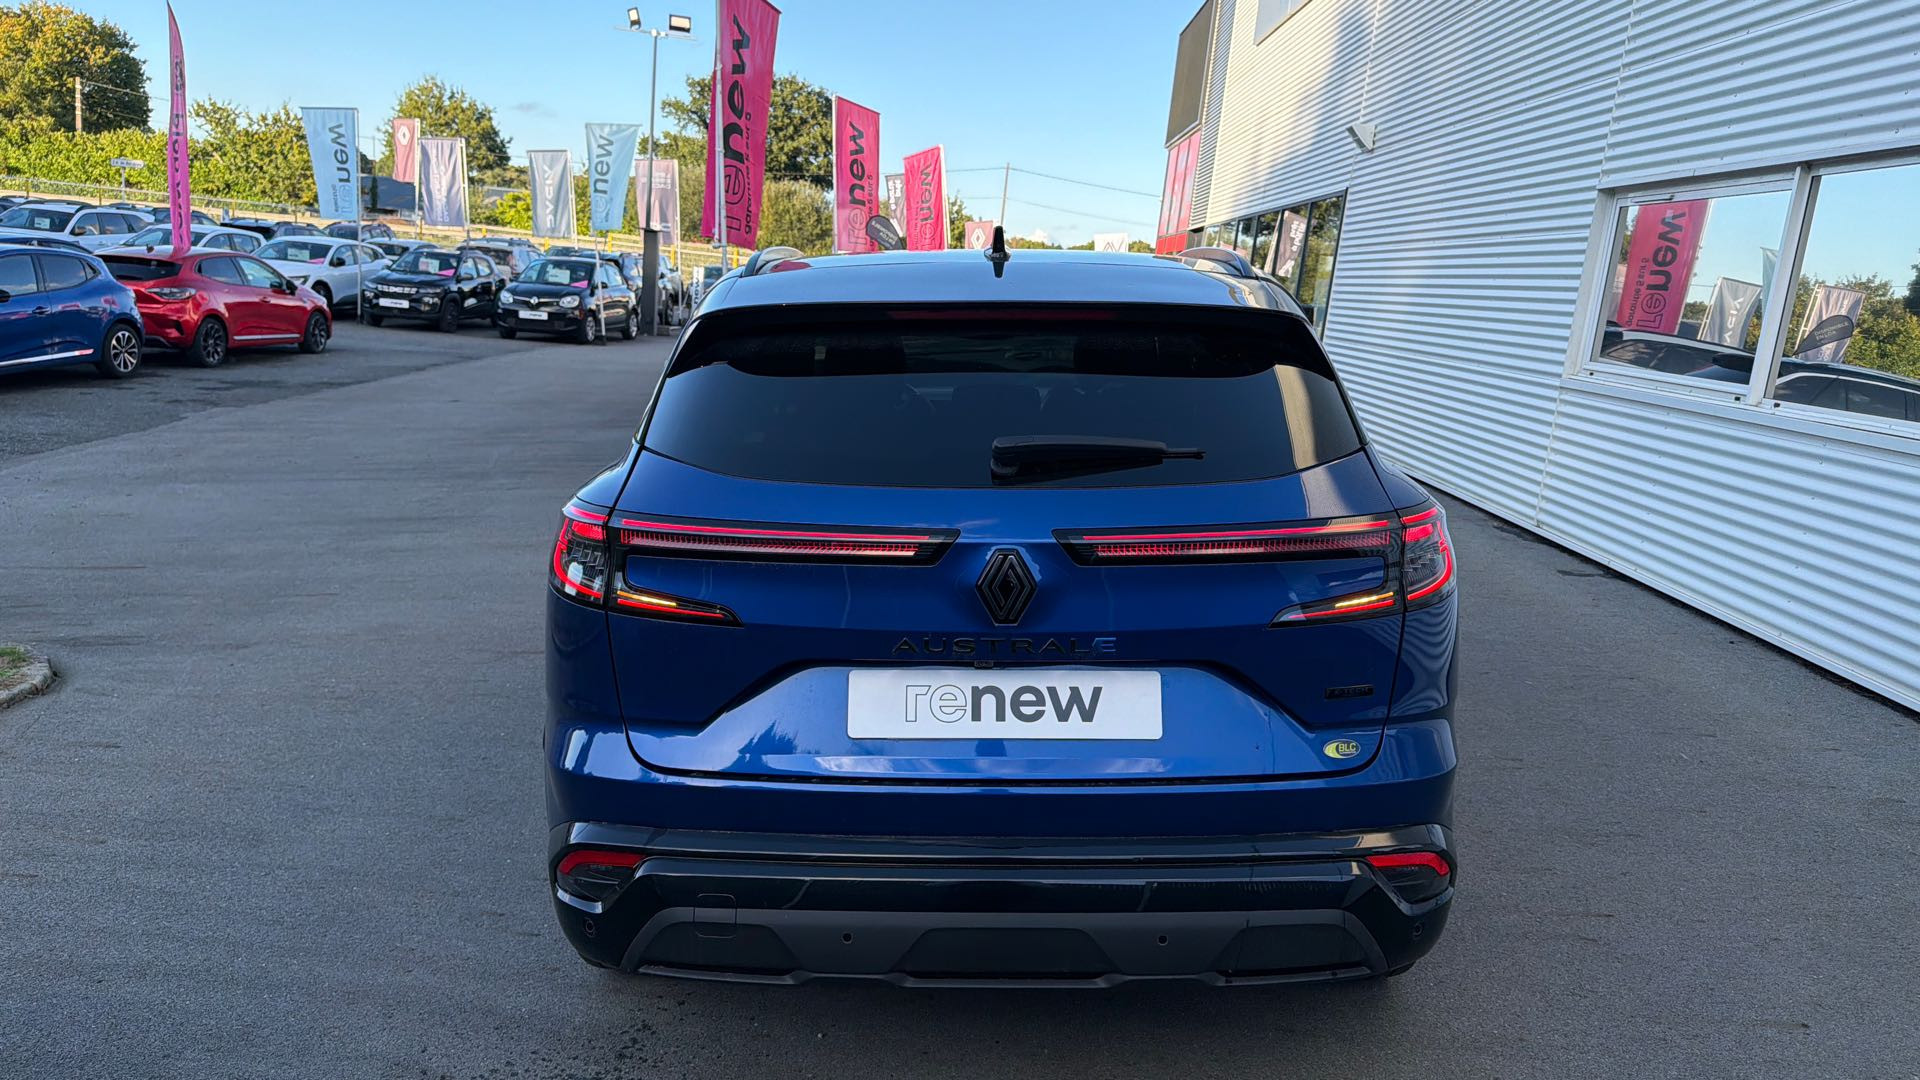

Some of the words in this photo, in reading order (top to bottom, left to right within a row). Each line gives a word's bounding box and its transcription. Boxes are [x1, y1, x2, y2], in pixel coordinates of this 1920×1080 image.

[848, 121, 867, 246] renew
[905, 684, 1103, 723] renew
[1338, 742, 1356, 752] BLC
